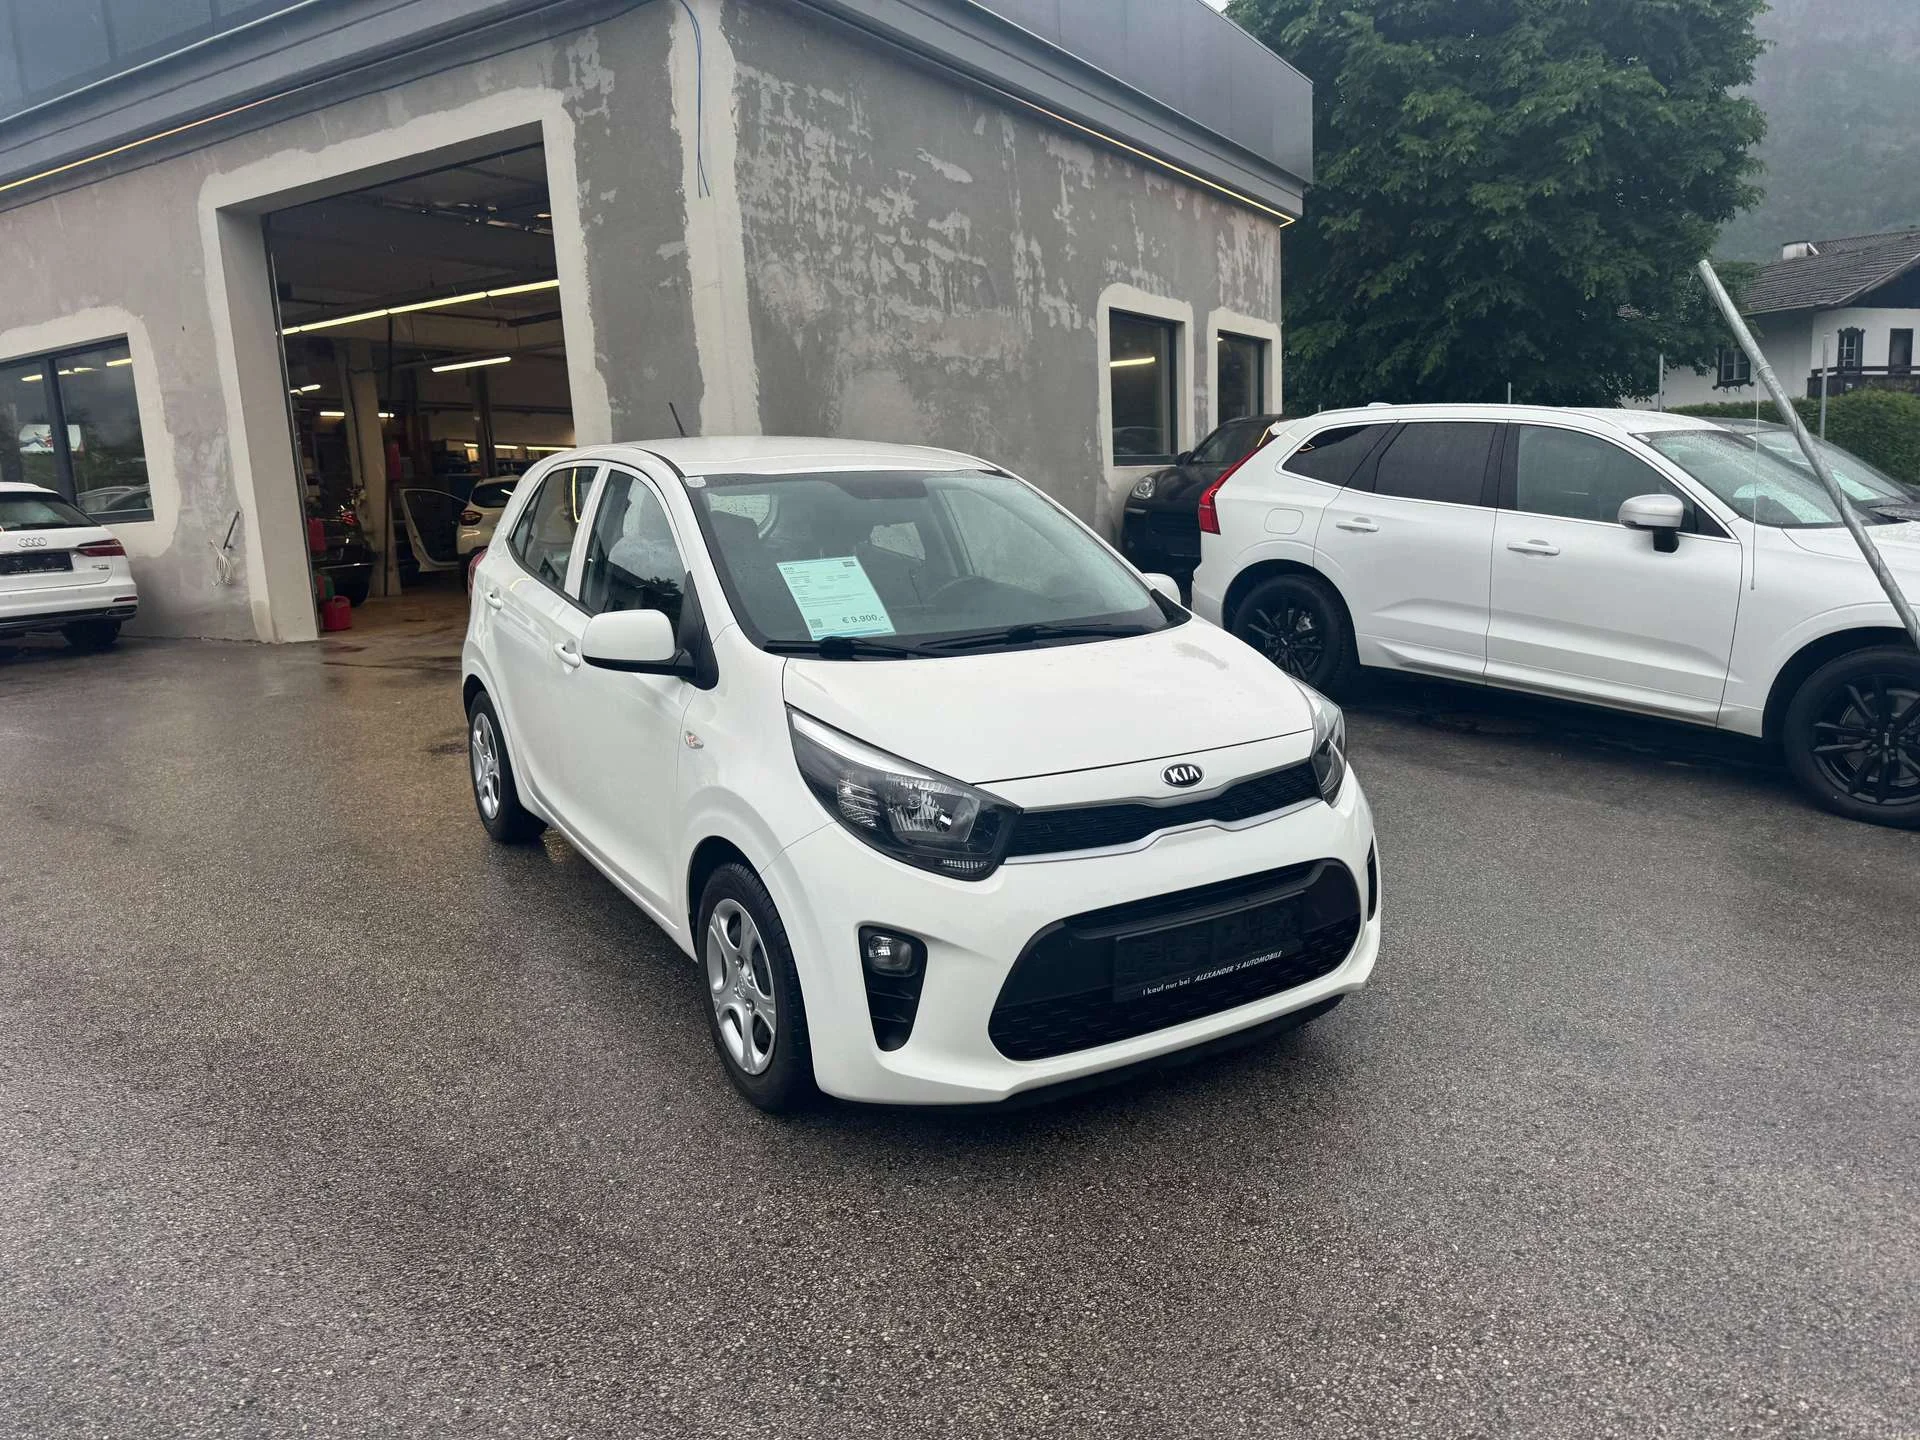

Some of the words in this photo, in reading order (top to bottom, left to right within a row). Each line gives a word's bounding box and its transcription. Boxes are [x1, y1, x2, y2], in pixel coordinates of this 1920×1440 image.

[1167, 765, 1200, 783] KIA
[1147, 984, 1164, 995] kauf
[1166, 982, 1178, 990] nur
[1179, 977, 1190, 986] bei
